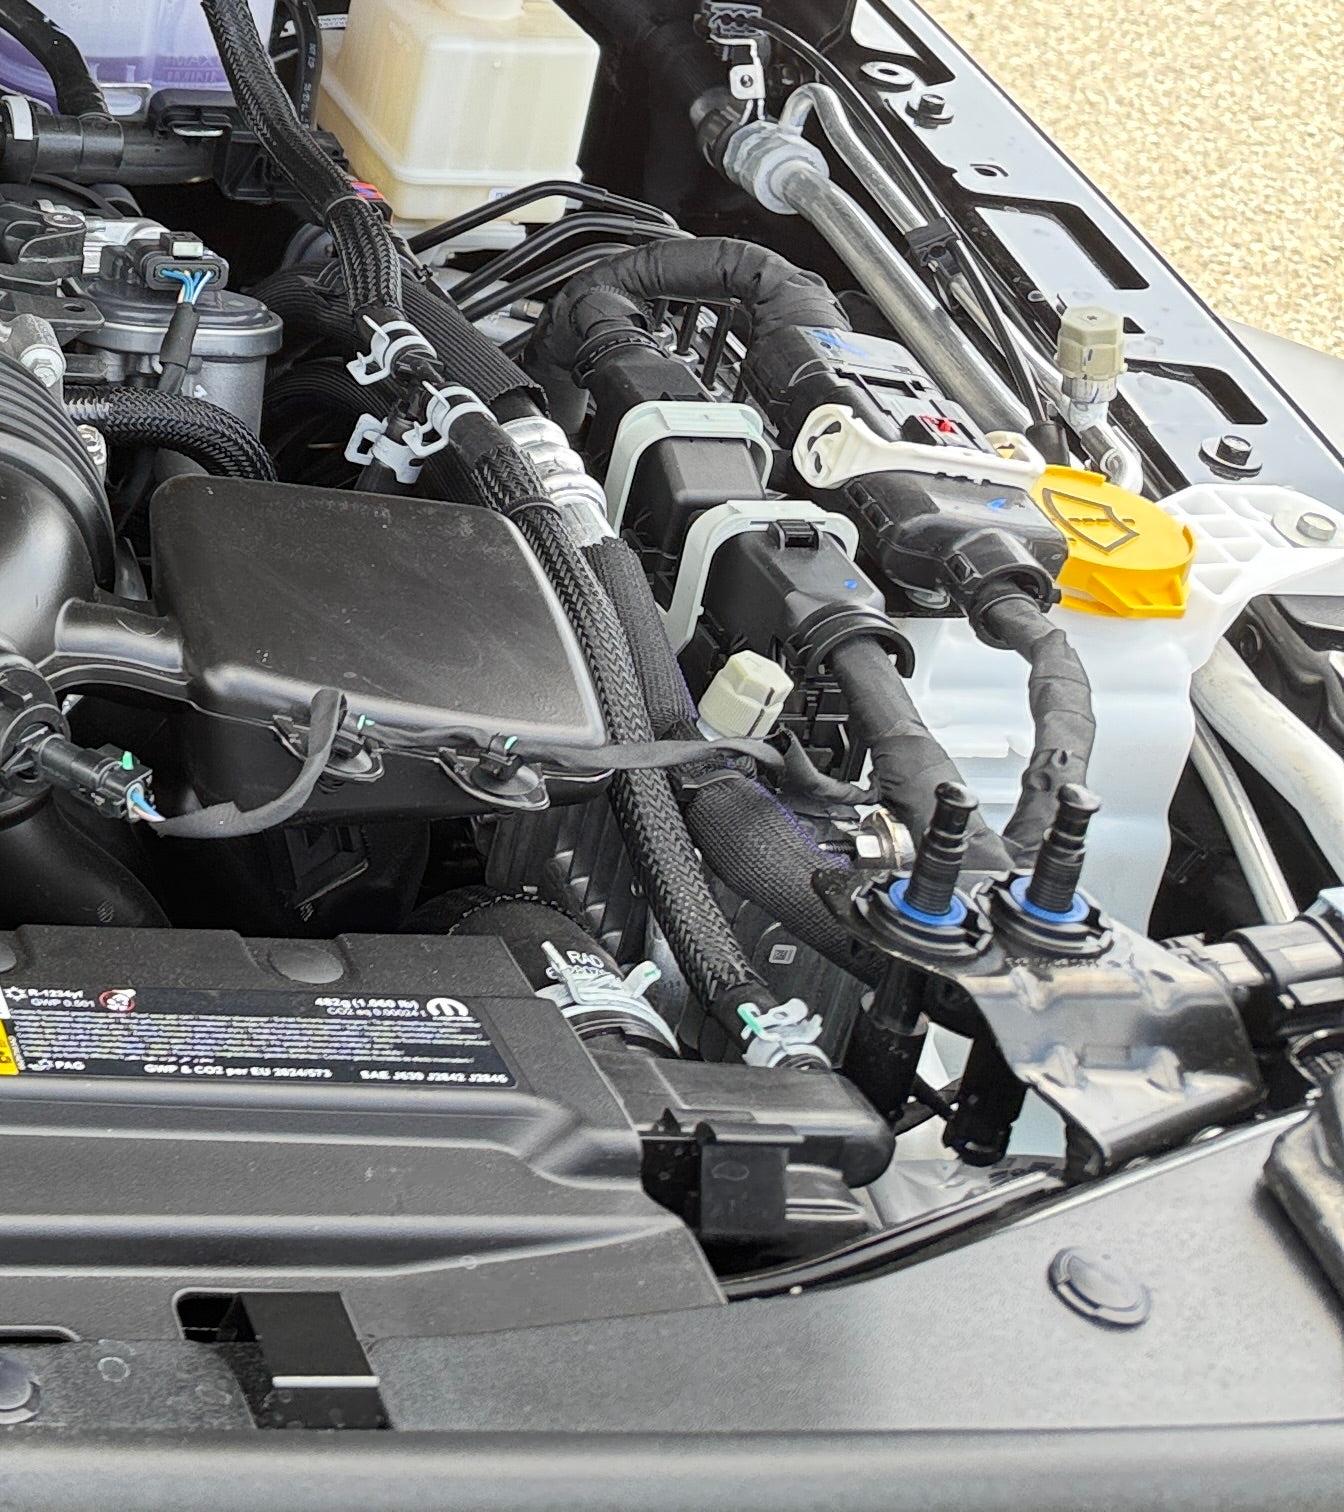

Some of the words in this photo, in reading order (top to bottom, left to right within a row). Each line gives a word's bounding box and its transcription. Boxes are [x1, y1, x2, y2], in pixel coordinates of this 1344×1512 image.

[566, 950, 604, 969] RAD
[55, 1061, 85, 1070] PAG
[144, 1064, 178, 1074] GWP
[194, 1065, 224, 1075] CO2
[360, 1070, 391, 1080] SAE
